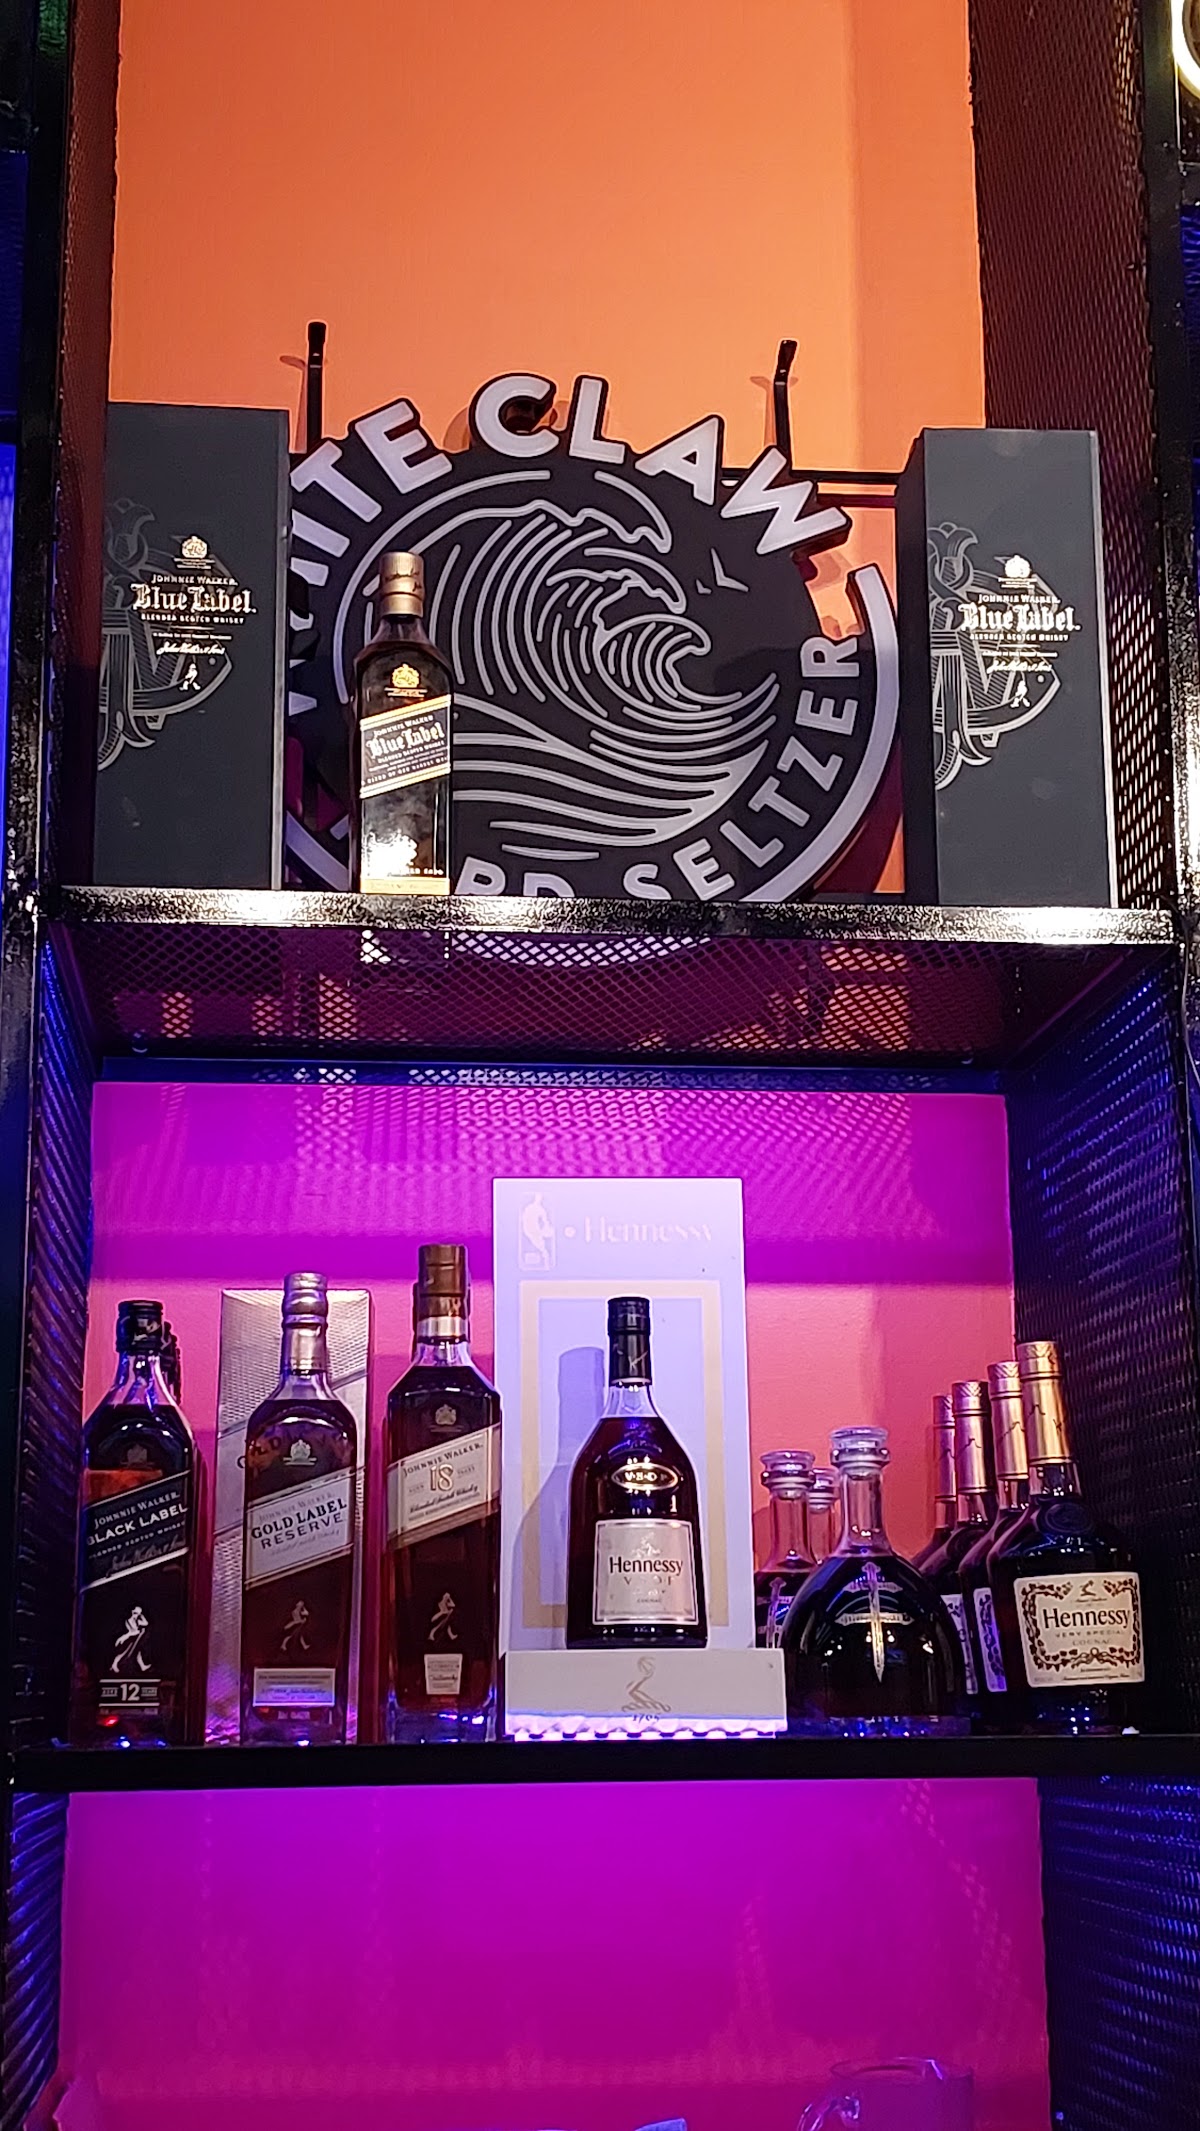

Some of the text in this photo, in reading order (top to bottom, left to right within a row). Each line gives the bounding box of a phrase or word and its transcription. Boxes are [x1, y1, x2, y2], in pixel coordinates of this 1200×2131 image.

[475, 376, 848, 554] CLAW
[151, 574, 194, 584] JOHNNIE
[130, 583, 188, 610] Blue
[978, 594, 1019, 604] JOHNNIE
[958, 602, 1013, 631] Blue
[366, 736, 406, 759] Blue
[401, 722, 445, 749] Label
[623, 636, 860, 900] SELTZER
[403, 1457, 442, 1478] JOHNNIE
[430, 1463, 453, 1491] 18
[87, 1503, 188, 1546] BLACK LABEL
[94, 1506, 136, 1530] JOHNNIE
[251, 1498, 347, 1539] GOLD LABEL
[260, 1513, 343, 1549] RESERVE
[609, 1556, 683, 1576] Hennessy
[1042, 1608, 1130, 1629] Hennessy
[120, 1683, 140, 1701] 12
